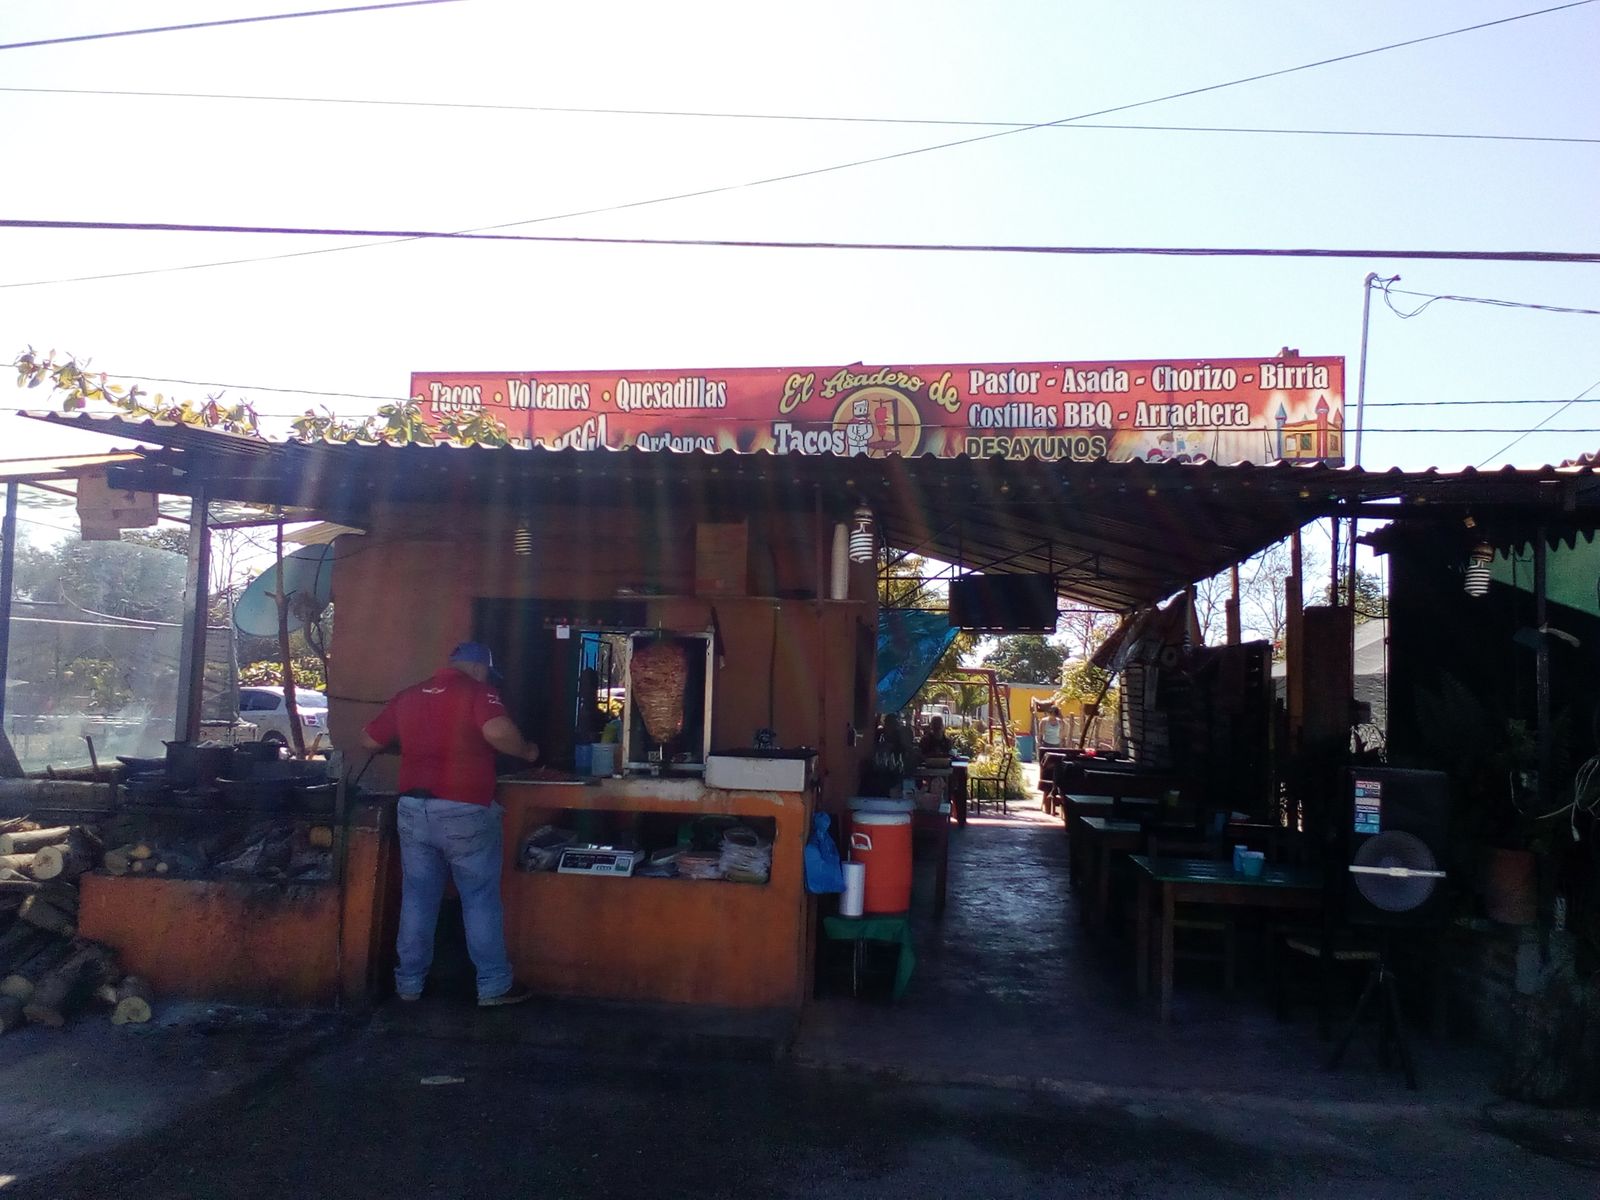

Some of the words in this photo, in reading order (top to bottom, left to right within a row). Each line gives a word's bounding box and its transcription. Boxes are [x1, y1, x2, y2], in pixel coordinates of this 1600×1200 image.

[429, 382, 483, 413] Tacos
[507, 379, 590, 411] Volcanes
[616, 377, 727, 412] Quesadillas
[779, 373, 815, 414] El
[820, 367, 924, 398] Asadero
[929, 371, 961, 414] de
[968, 368, 1041, 395] Pastor
[1062, 367, 1129, 394] Asada
[1152, 365, 1238, 392] Chorizo
[1259, 362, 1329, 391] Birria
[968, 402, 1058, 428] Costillas
[1063, 401, 1112, 429] BBQ
[1134, 400, 1250, 427] Arrachera
[774, 422, 846, 455] Tacos
[966, 436, 1106, 460] DESAYUNOS
